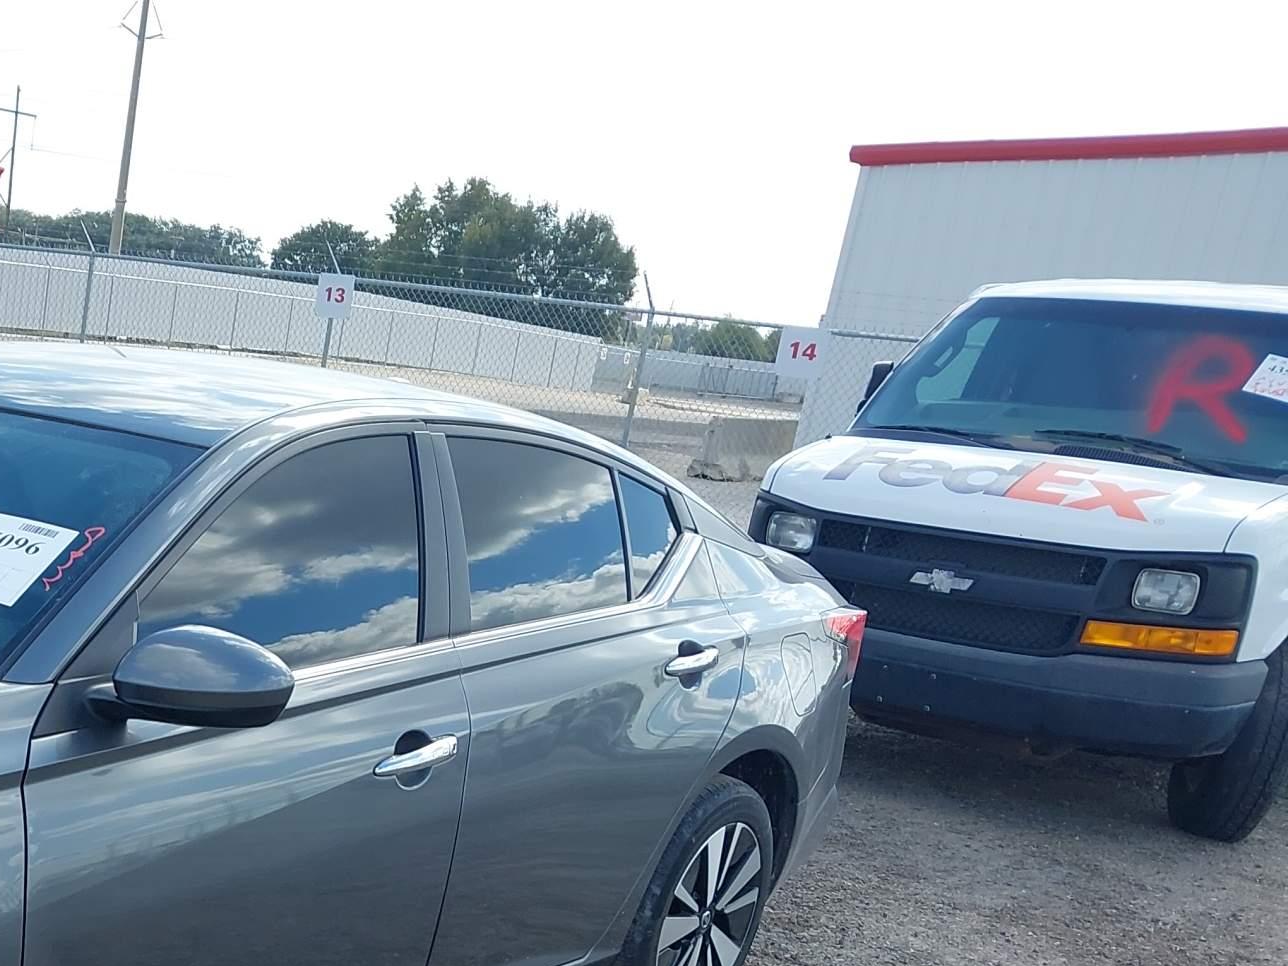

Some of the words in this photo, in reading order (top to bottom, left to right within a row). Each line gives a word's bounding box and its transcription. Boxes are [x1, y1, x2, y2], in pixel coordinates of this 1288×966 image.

[325, 286, 346, 303] 13
[790, 341, 817, 361] 14
[1146, 333, 1256, 445] R
[823, 443, 1171, 523] FedEx
